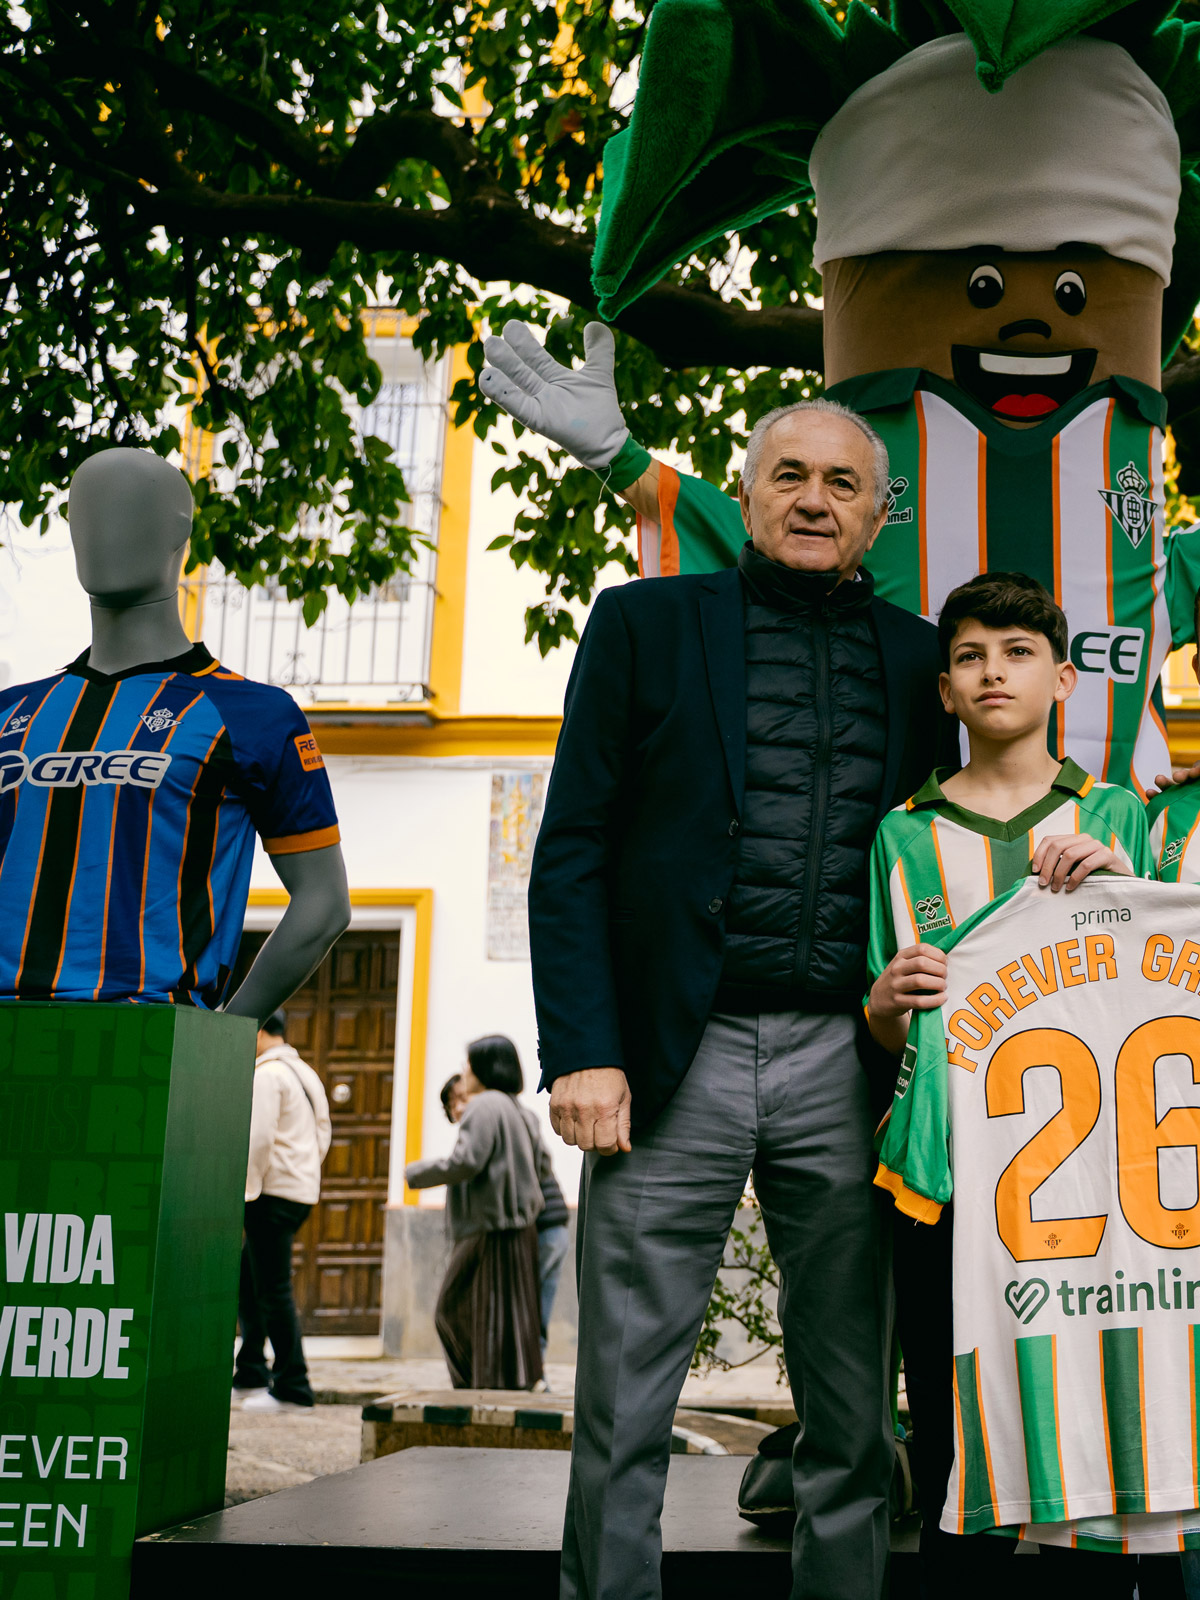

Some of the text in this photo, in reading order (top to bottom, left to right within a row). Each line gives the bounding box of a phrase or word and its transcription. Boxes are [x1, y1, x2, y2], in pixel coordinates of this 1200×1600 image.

[1070, 631, 1142, 676] EE
[31, 754, 167, 783] GREE
[916, 914, 953, 934] hummel
[1071, 906, 1132, 931] prima
[946, 933, 1119, 1074] FOREVER
[4, 1213, 115, 1285] VIDA
